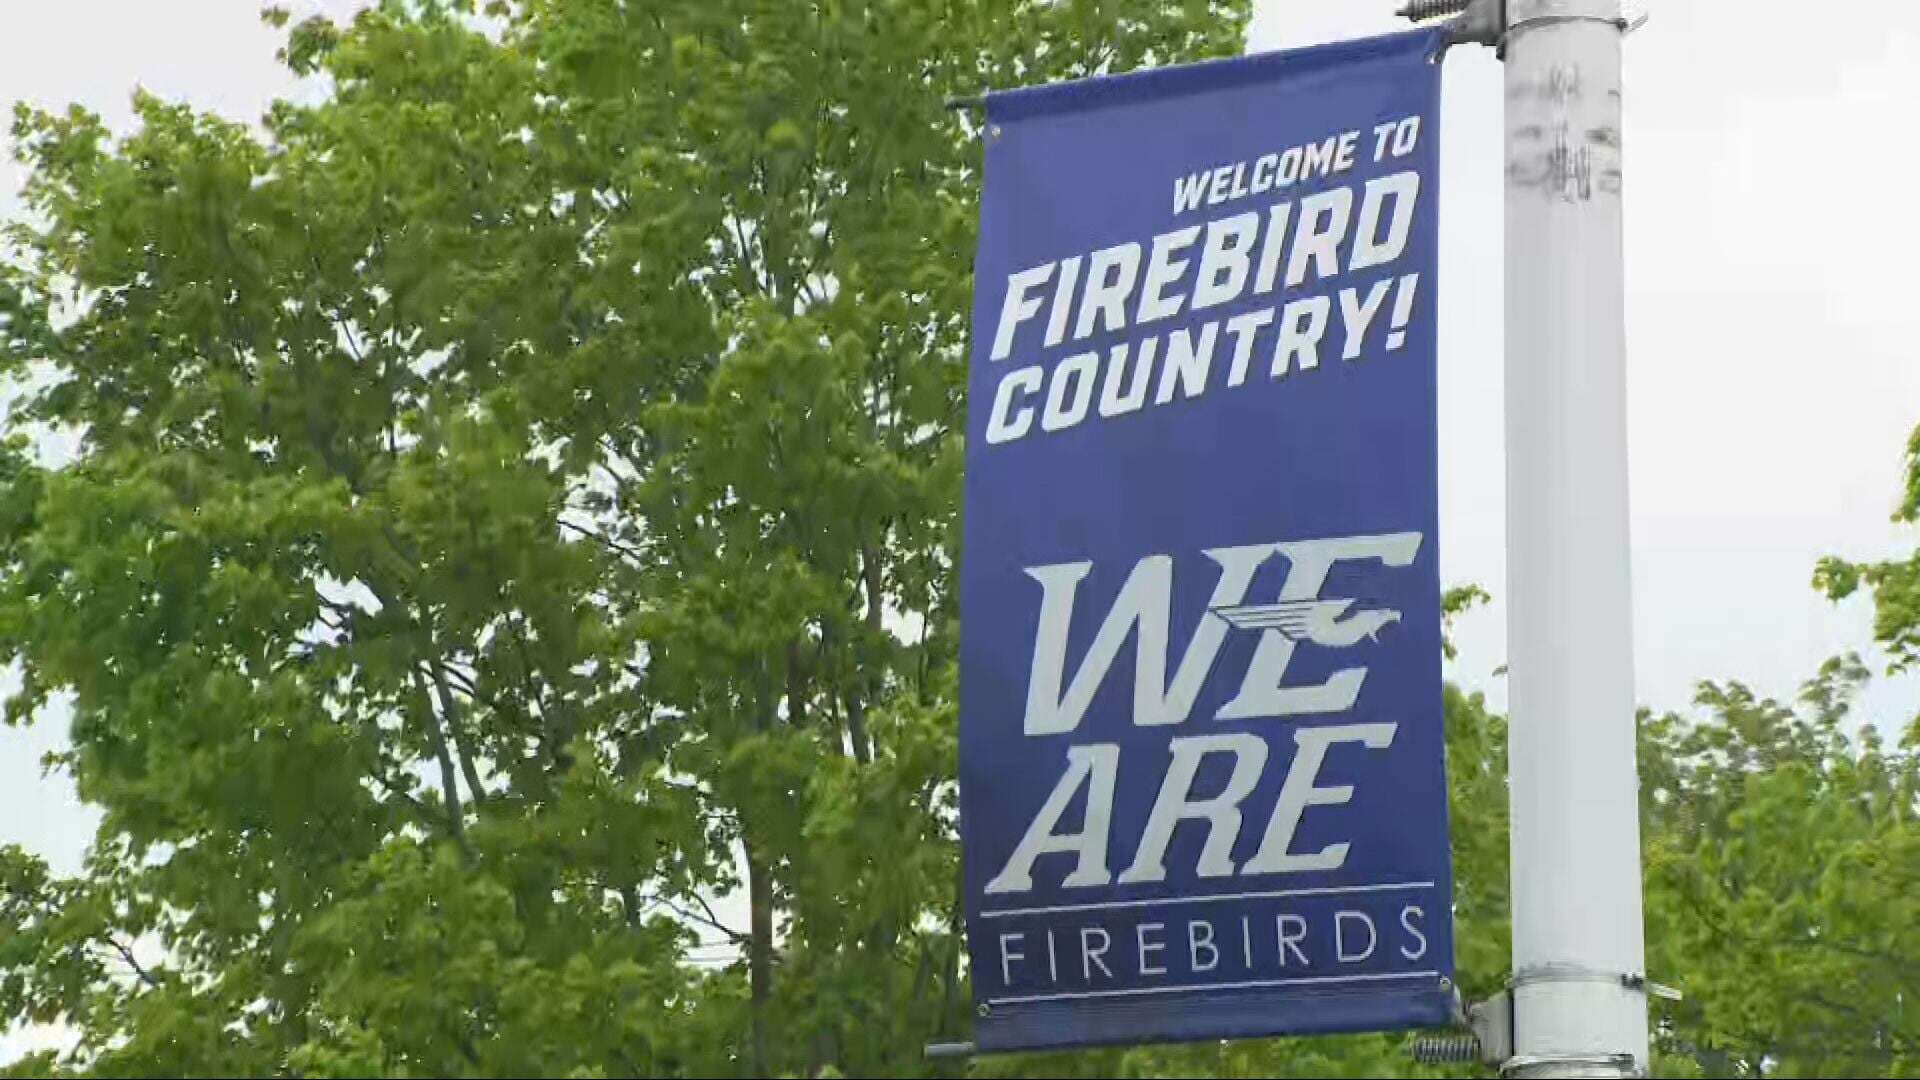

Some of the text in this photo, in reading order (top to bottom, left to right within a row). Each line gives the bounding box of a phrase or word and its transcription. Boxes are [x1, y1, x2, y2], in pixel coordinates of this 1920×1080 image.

[1173, 115, 1421, 215] WELCOME TO
[989, 170, 1421, 362] FIREBIRD
[985, 272, 1420, 445] COUNTRY!
[1023, 531, 1423, 736] WE
[984, 721, 1398, 894] ARE
[999, 905, 1428, 985] FIREBIRDS
